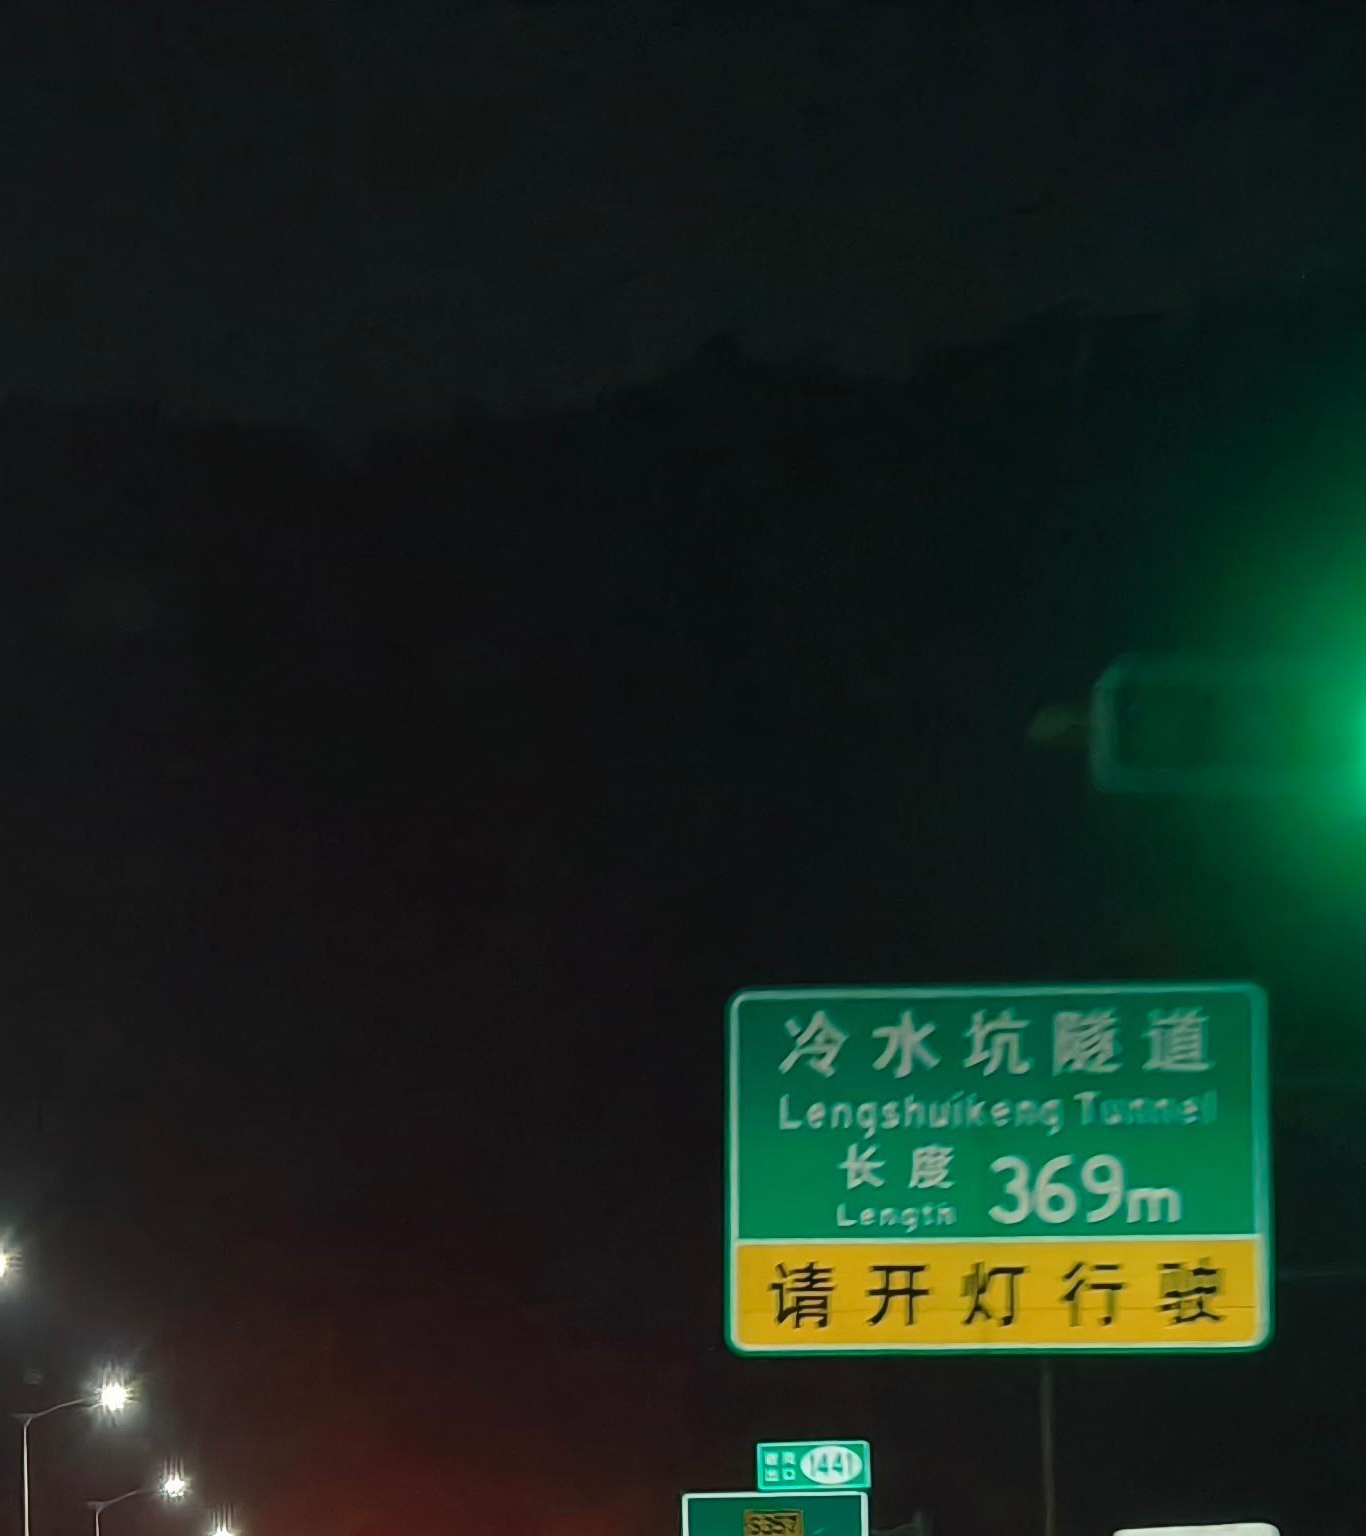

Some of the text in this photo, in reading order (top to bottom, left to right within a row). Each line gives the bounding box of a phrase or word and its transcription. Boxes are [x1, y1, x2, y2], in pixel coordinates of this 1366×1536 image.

[778, 1008, 1217, 1077] 冷水坑隧道
[778, 1089, 1218, 1138] Lengshuikeng Tunnel
[838, 1143, 956, 1191] 长度
[988, 1153, 1183, 1225] 369m
[836, 1202, 957, 1233] Length
[769, 1257, 1228, 1329] 请开灯行驶
